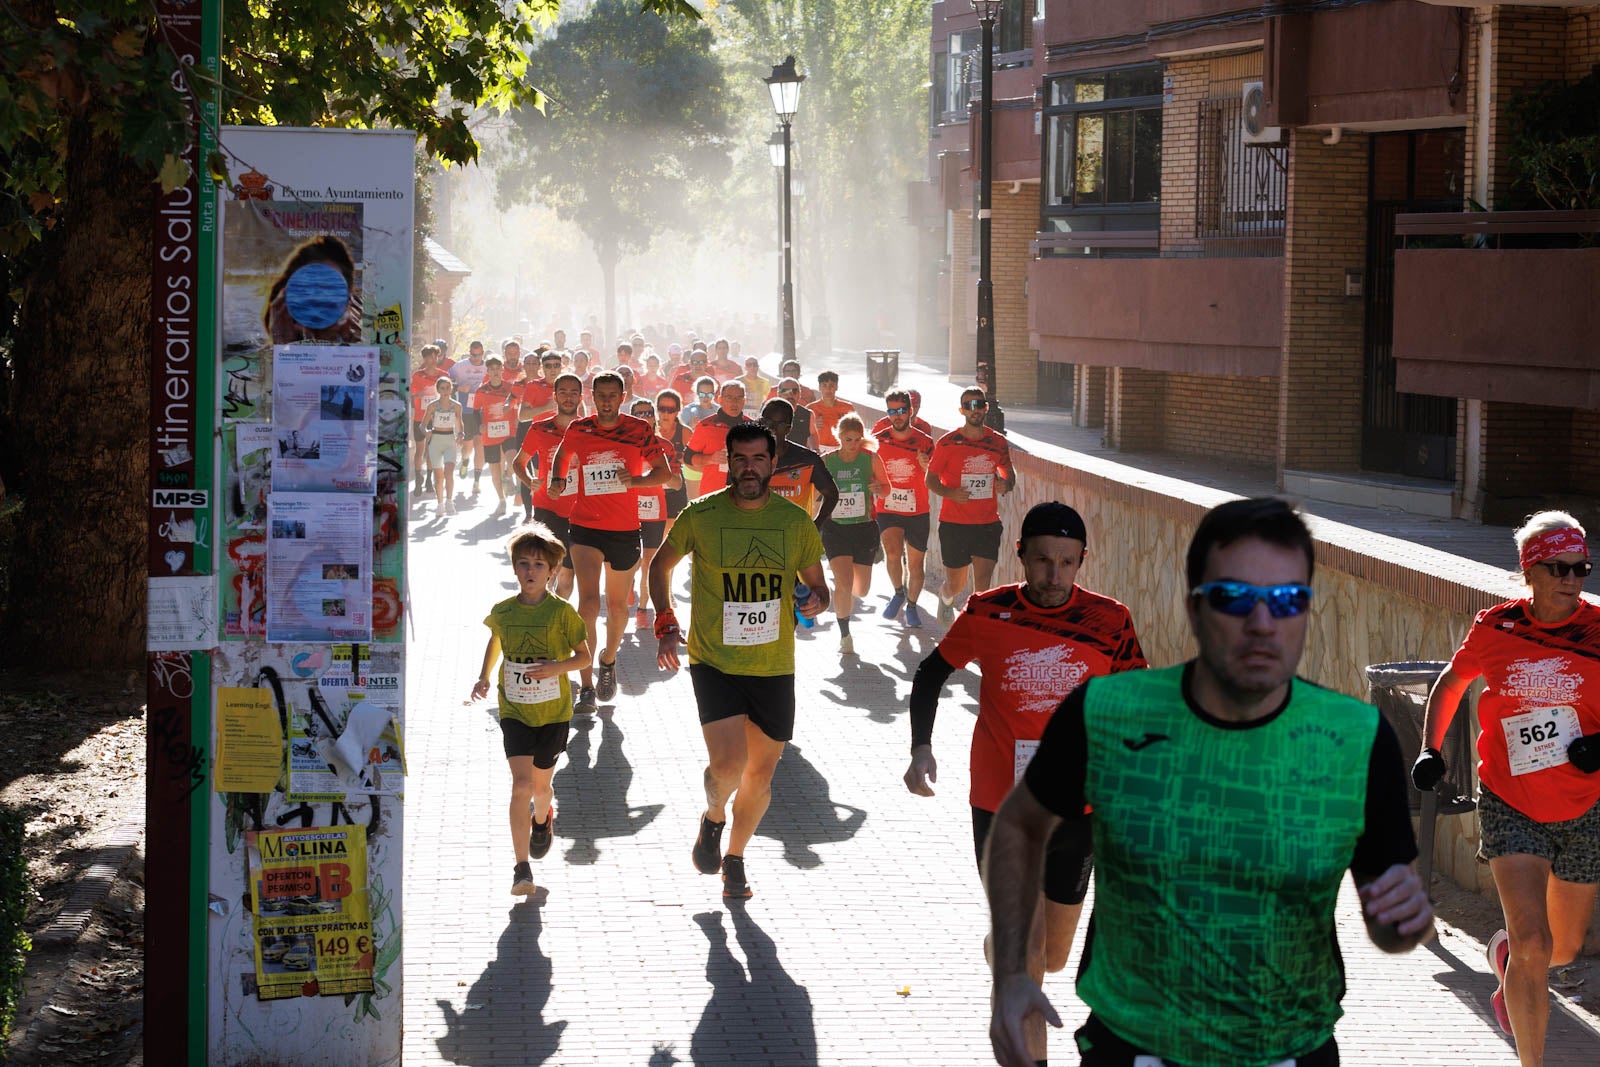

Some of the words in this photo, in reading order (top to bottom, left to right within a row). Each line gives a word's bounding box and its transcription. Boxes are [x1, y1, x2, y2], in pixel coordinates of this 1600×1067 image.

[326, 187, 404, 201] Ayuntamiento
[202, 202, 214, 232] Ruta
[590, 469, 618, 481] 1137
[969, 479, 987, 488] 729
[156, 492, 206, 505] MPS
[839, 497, 856, 506] 730
[892, 493, 908, 501] 944
[737, 611, 767, 625] 760
[513, 671, 541, 685] 76
[1008, 665, 1080, 679] carrera
[321, 677, 349, 687] OFERTA
[1507, 674, 1576, 690] carrera
[1507, 687, 1576, 701] cruzroja.es
[1520, 720, 1560, 745] 562
[1533, 741, 1555, 752] ESTHER
[268, 882, 312, 893] PERMISO
[319, 863, 353, 900] B
[287, 924, 319, 935] CLASES
[317, 936, 349, 957] 149
[356, 935, 370, 954] €
